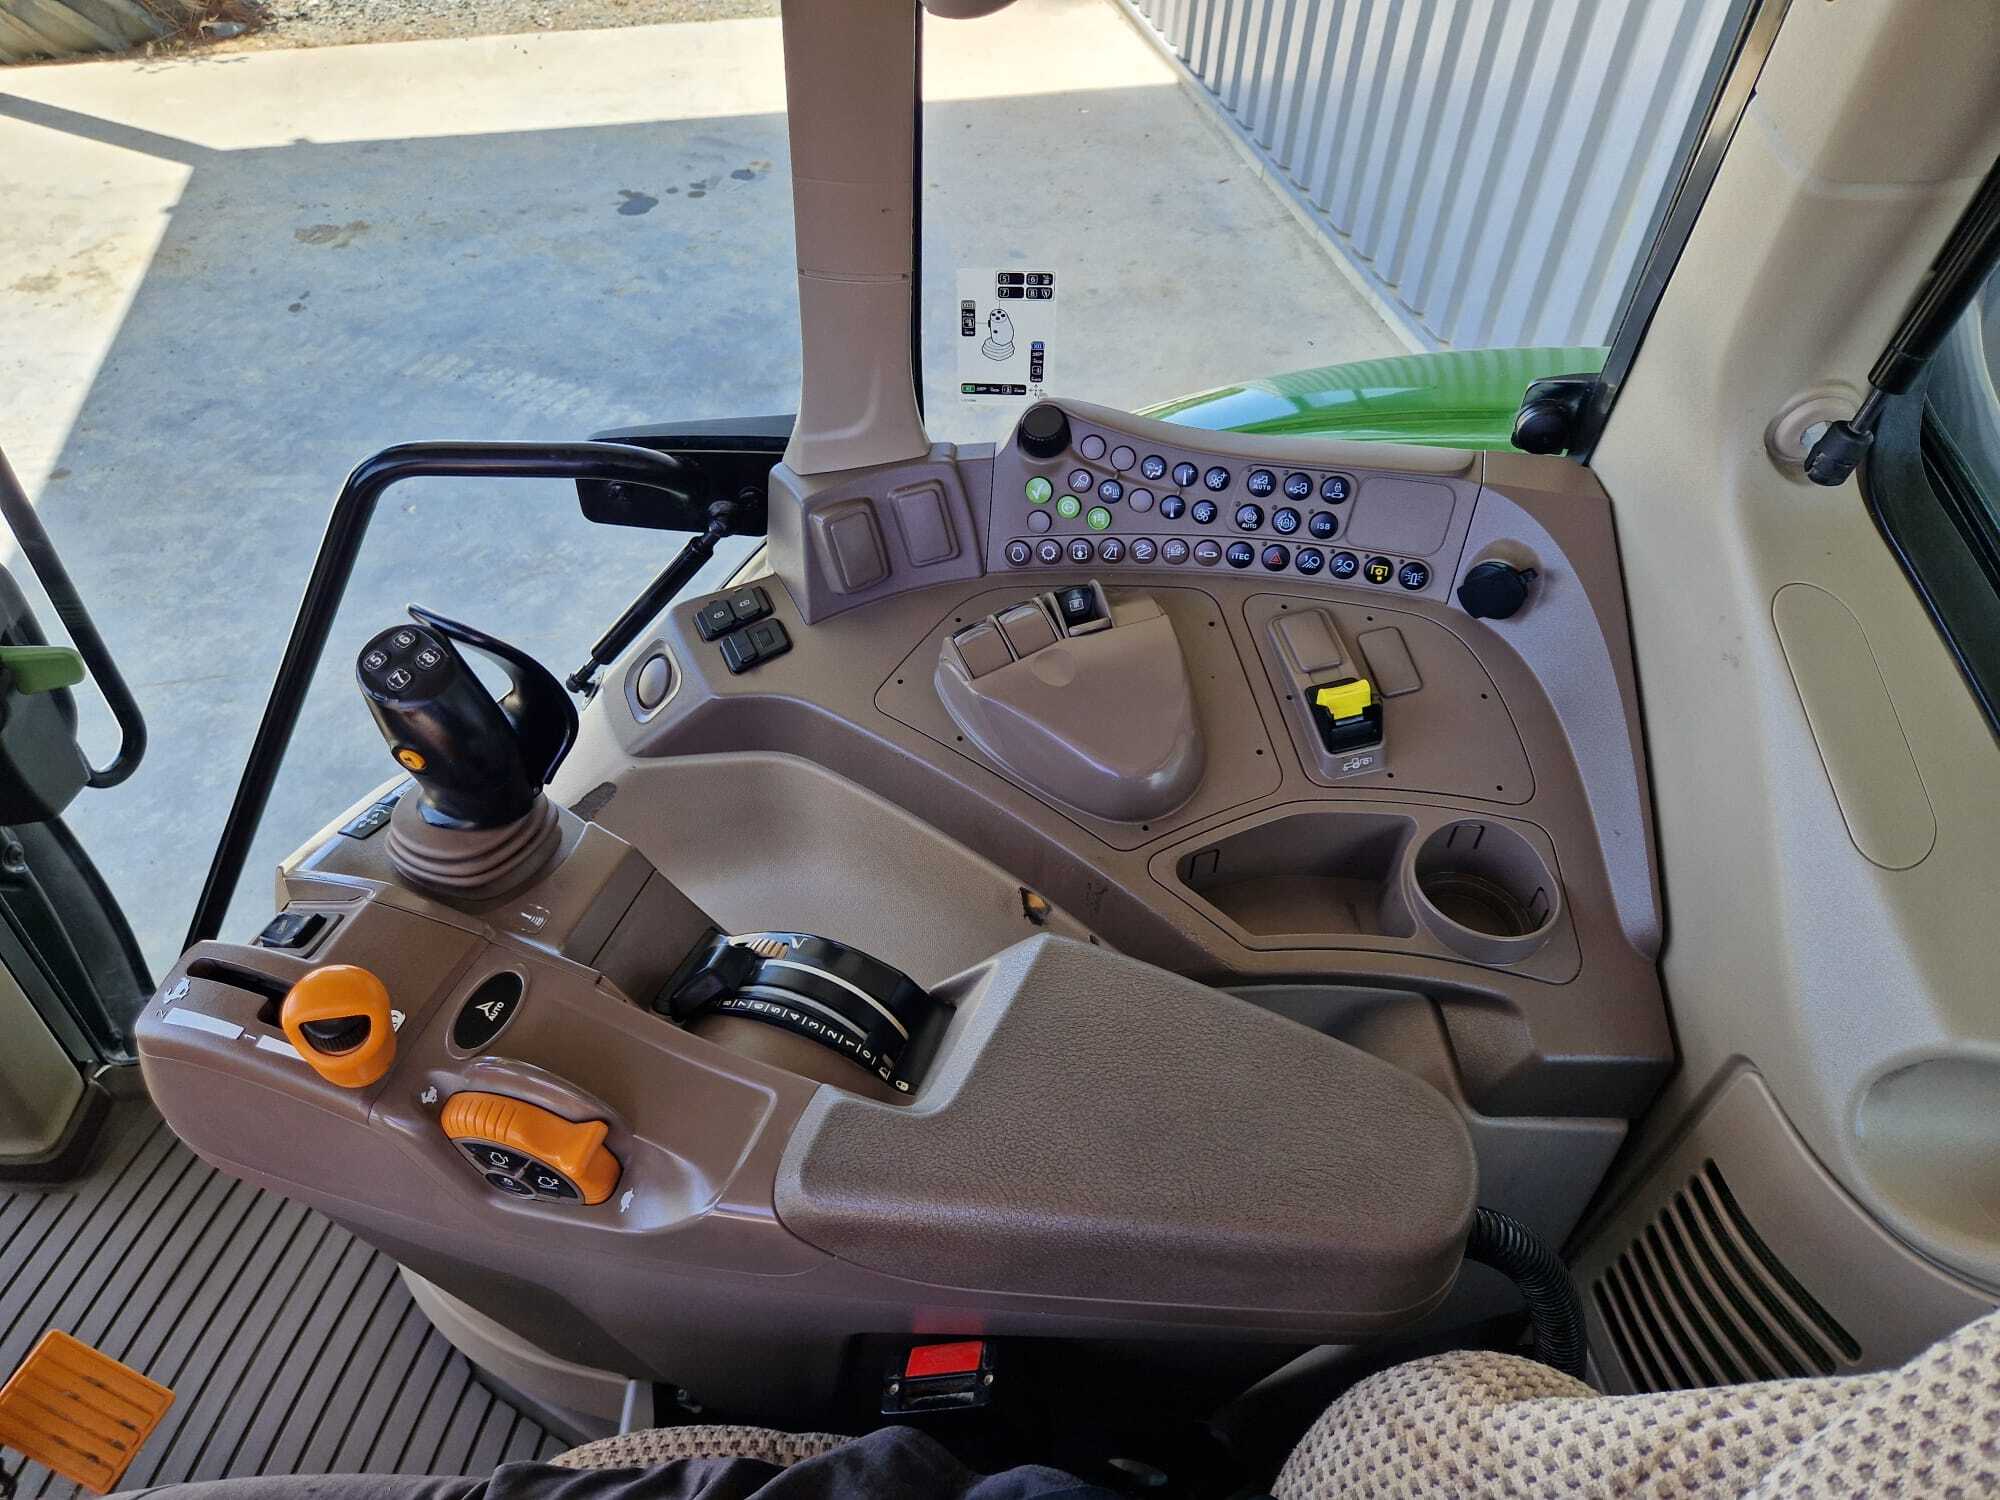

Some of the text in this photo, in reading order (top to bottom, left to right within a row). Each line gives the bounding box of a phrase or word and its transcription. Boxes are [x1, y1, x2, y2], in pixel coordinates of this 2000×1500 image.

[370, 654, 382, 665] 5
[422, 652, 435, 663] 8
[392, 673, 404, 684] 7
[488, 1001, 505, 1022] AUTO
[790, 1012, 800, 1021] 4
[809, 1021, 819, 1029] 3
[827, 1030, 837, 1039] 2
[862, 1050, 871, 1059] 0
